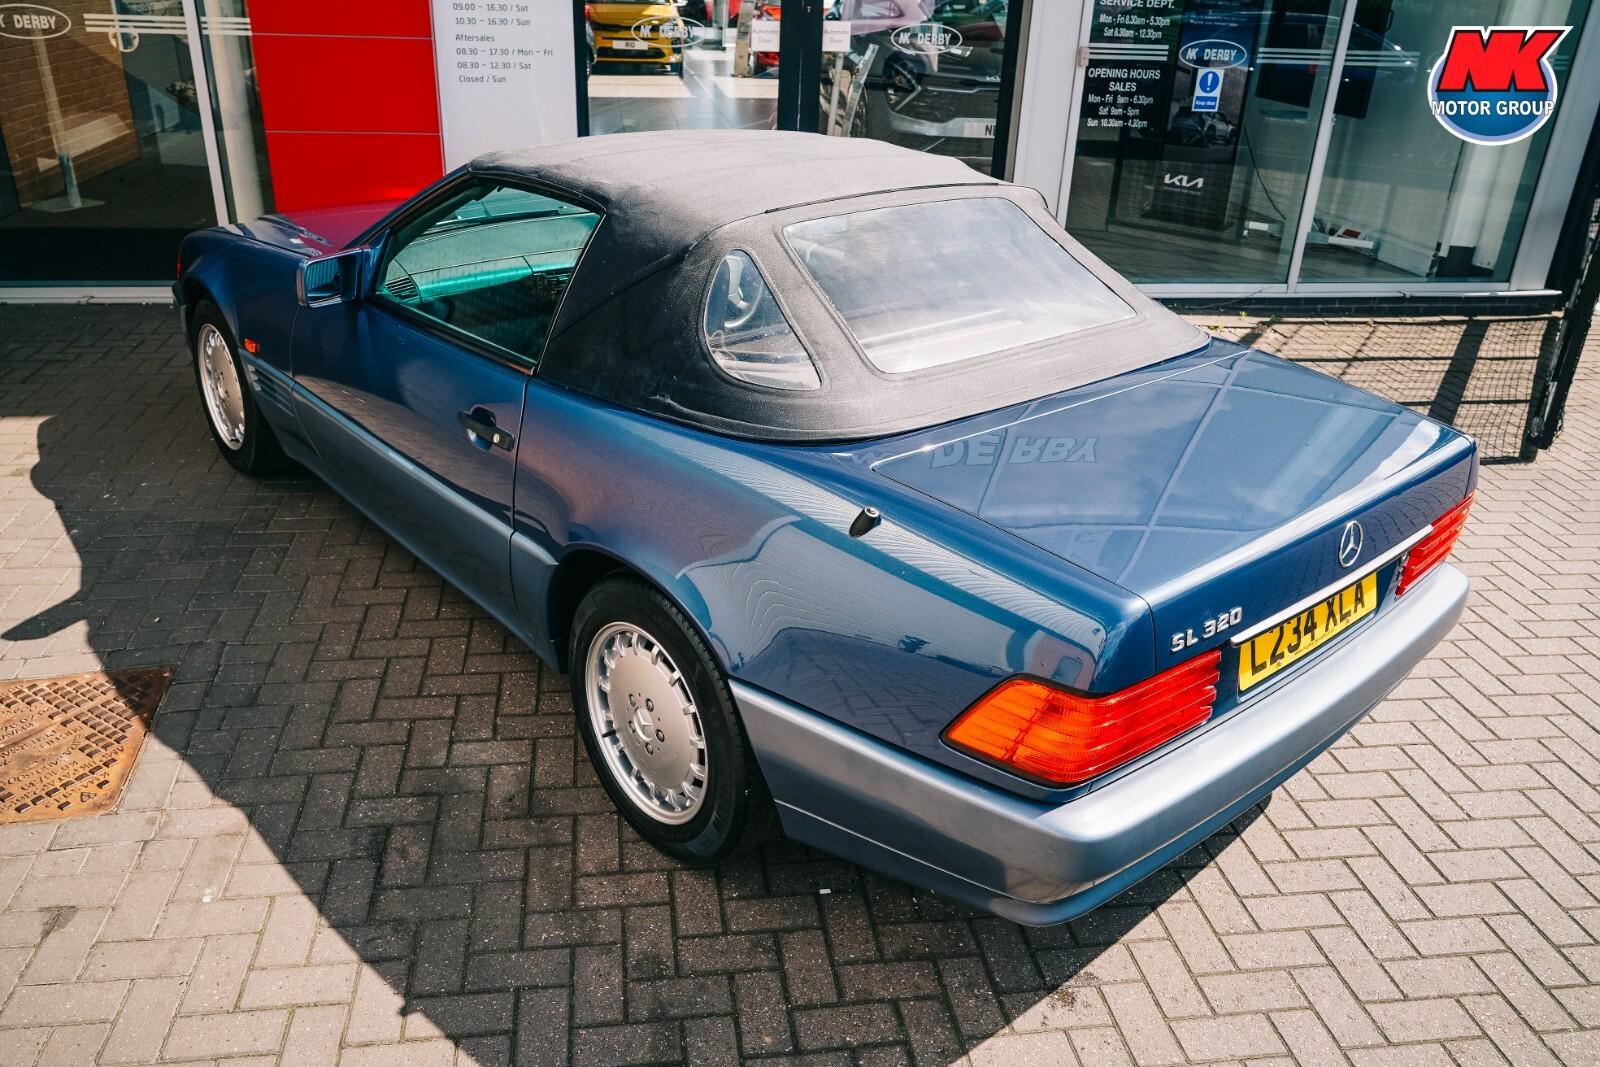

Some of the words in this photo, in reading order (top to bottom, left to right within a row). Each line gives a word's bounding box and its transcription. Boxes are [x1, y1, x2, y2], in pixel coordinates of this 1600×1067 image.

[452, 2, 476, 11] 09.00
[486, 3, 508, 12] 16.30
[515, 4, 528, 12] Sat
[1146, 0, 1175, 9] DEPT.
[13, 14, 56, 30] DERBY
[455, 17, 477, 25] 10.30
[487, 18, 508, 26] 16.30
[516, 18, 531, 26] Sun
[1099, 13, 1112, 23] Mon
[1116, 14, 1125, 24] Fri
[1125, 15, 1145, 25] 8.30am
[1150, 16, 1170, 28] 5.30pm
[659, 25, 693, 38] DERBY
[1103, 27, 1113, 36] Sat
[1114, 28, 1134, 38] 8.30am
[1140, 29, 1162, 40] 12.30pm
[455, 33, 495, 42] Aftersales
[917, 32, 952, 45] DERBY
[456, 47, 478, 56] 08.30
[489, 48, 509, 56] 17.30
[517, 48, 534, 56] Mon
[1203, 49, 1237, 61] DERBY
[457, 61, 479, 69] 08.30
[490, 62, 511, 70] 12.30
[519, 62, 531, 70] Sat
[1088, 67, 1128, 78] OPENING
[1129, 69, 1161, 79] HOURS
[458, 75, 484, 83] Closed
[492, 75, 507, 83] Sun
[1109, 81, 1137, 92] SALES
[1088, 94, 1101, 103] Mon
[1105, 94, 1113, 103] Fri
[1116, 94, 1129, 104] 9am
[1133, 95, 1154, 105] 6.30pm
[1098, 106, 1108, 115] Sat
[1110, 106, 1123, 116] 9am
[1127, 106, 1139, 117] 5pm
[1087, 117, 1098, 127] Sun
[1101, 118, 1123, 127] 10.30am
[1127, 119, 1148, 128] 4.30pm
[1163, 173, 1204, 189] KIA
[1170, 628, 1199, 653] SL
[1202, 606, 1243, 640] 320
[1250, 608, 1318, 677] L234
[1324, 580, 1366, 632] XLA
